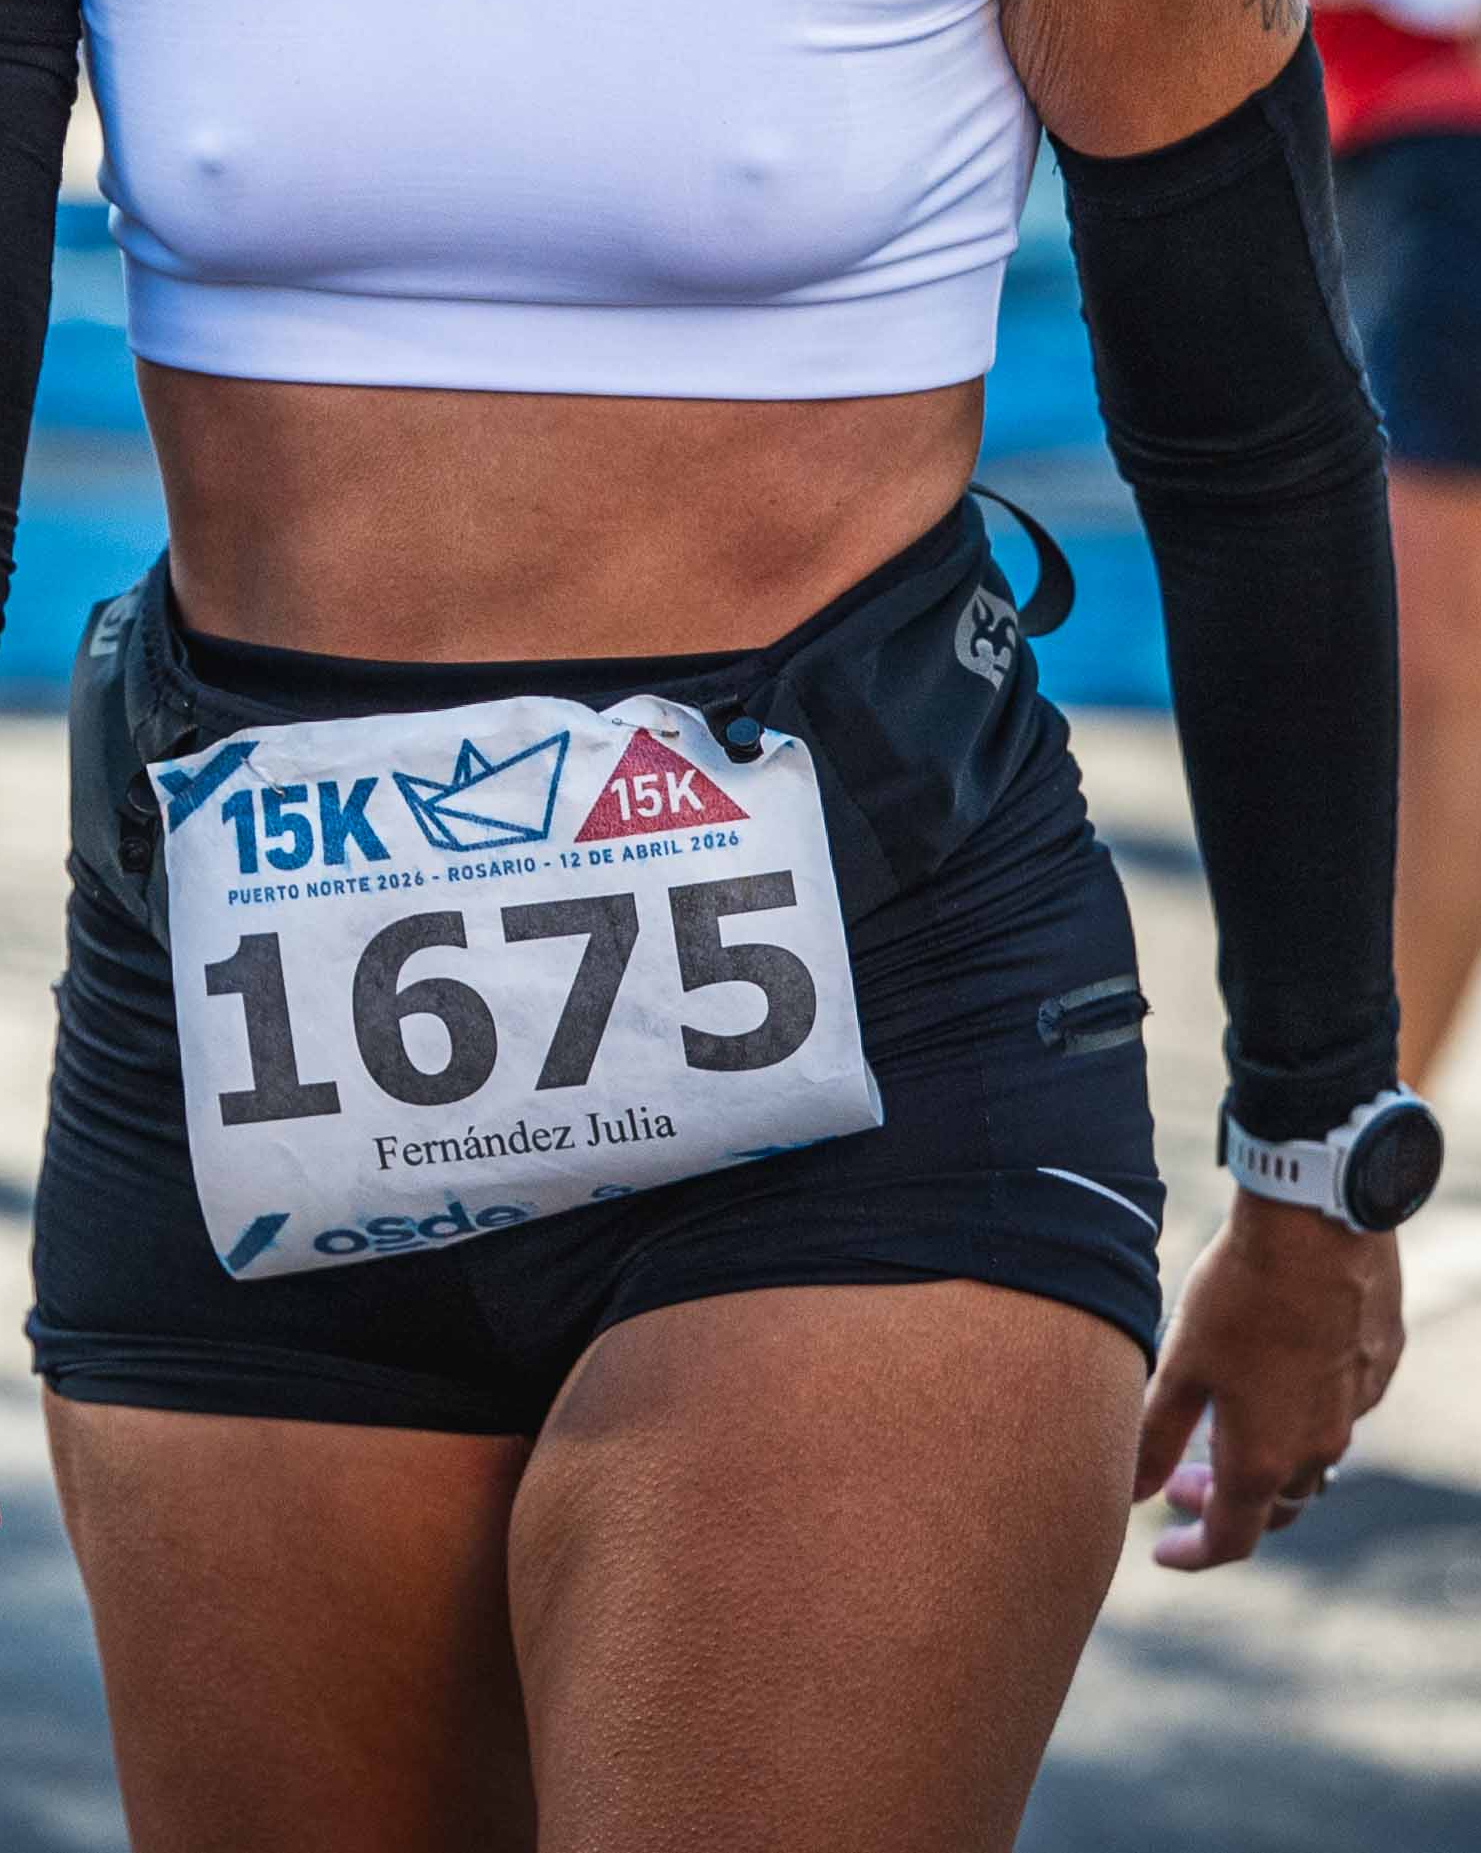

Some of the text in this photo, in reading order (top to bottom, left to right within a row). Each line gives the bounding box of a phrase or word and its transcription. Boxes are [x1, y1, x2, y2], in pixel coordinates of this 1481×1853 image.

[221, 776, 392, 875] 15K
[609, 768, 706, 822] 15K
[227, 884, 300, 906] PUERTO
[306, 876, 372, 899] NORTE
[376, 871, 425, 892] 2026
[447, 857, 537, 883] ROSARIO
[559, 852, 582, 870] 12
[589, 848, 614, 867] DE
[621, 837, 684, 863] ABRIL
[691, 830, 741, 852] 2026
[204, 870, 818, 1126] 1675
[372, 1106, 678, 1171] Fernández Julia
[312, 1191, 532, 1256] osde
